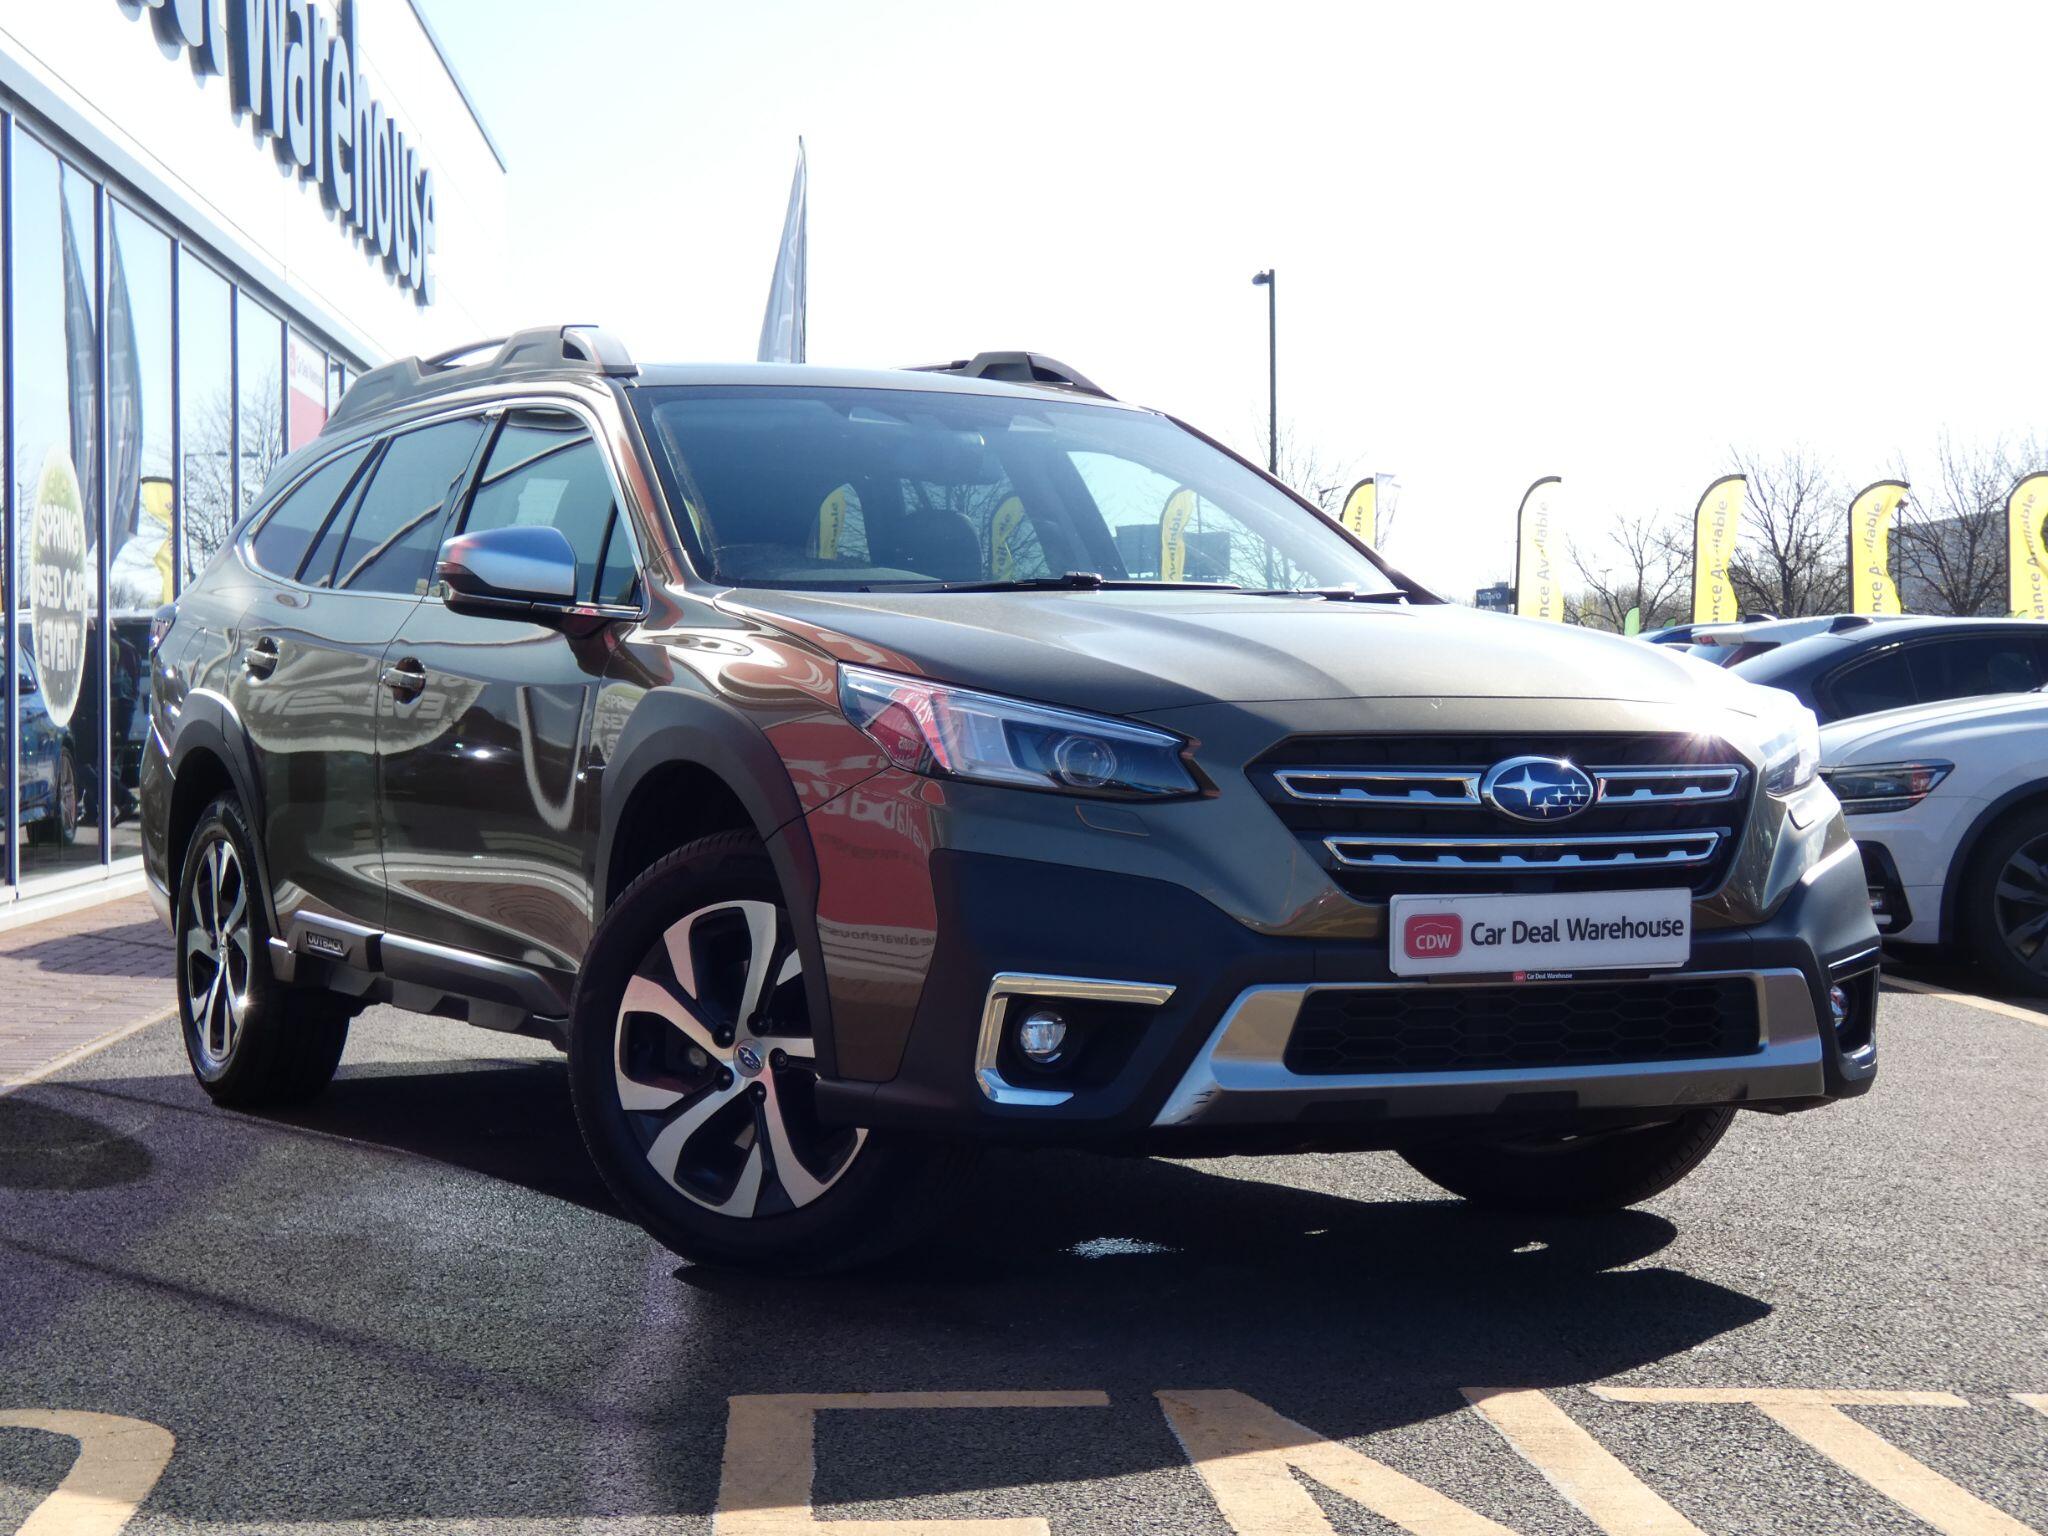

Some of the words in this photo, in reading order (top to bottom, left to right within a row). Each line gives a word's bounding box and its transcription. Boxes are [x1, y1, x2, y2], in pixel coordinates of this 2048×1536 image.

[38, 503, 80, 556] SPRING
[34, 564, 63, 610] USED
[41, 616, 78, 673] EVENT
[307, 935, 343, 952] OUTBACK
[1415, 934, 1453, 950] CDW
[1470, 922, 1506, 946] Car
[1512, 920, 1561, 945] Deal
[1567, 916, 1685, 942] Warehouse
